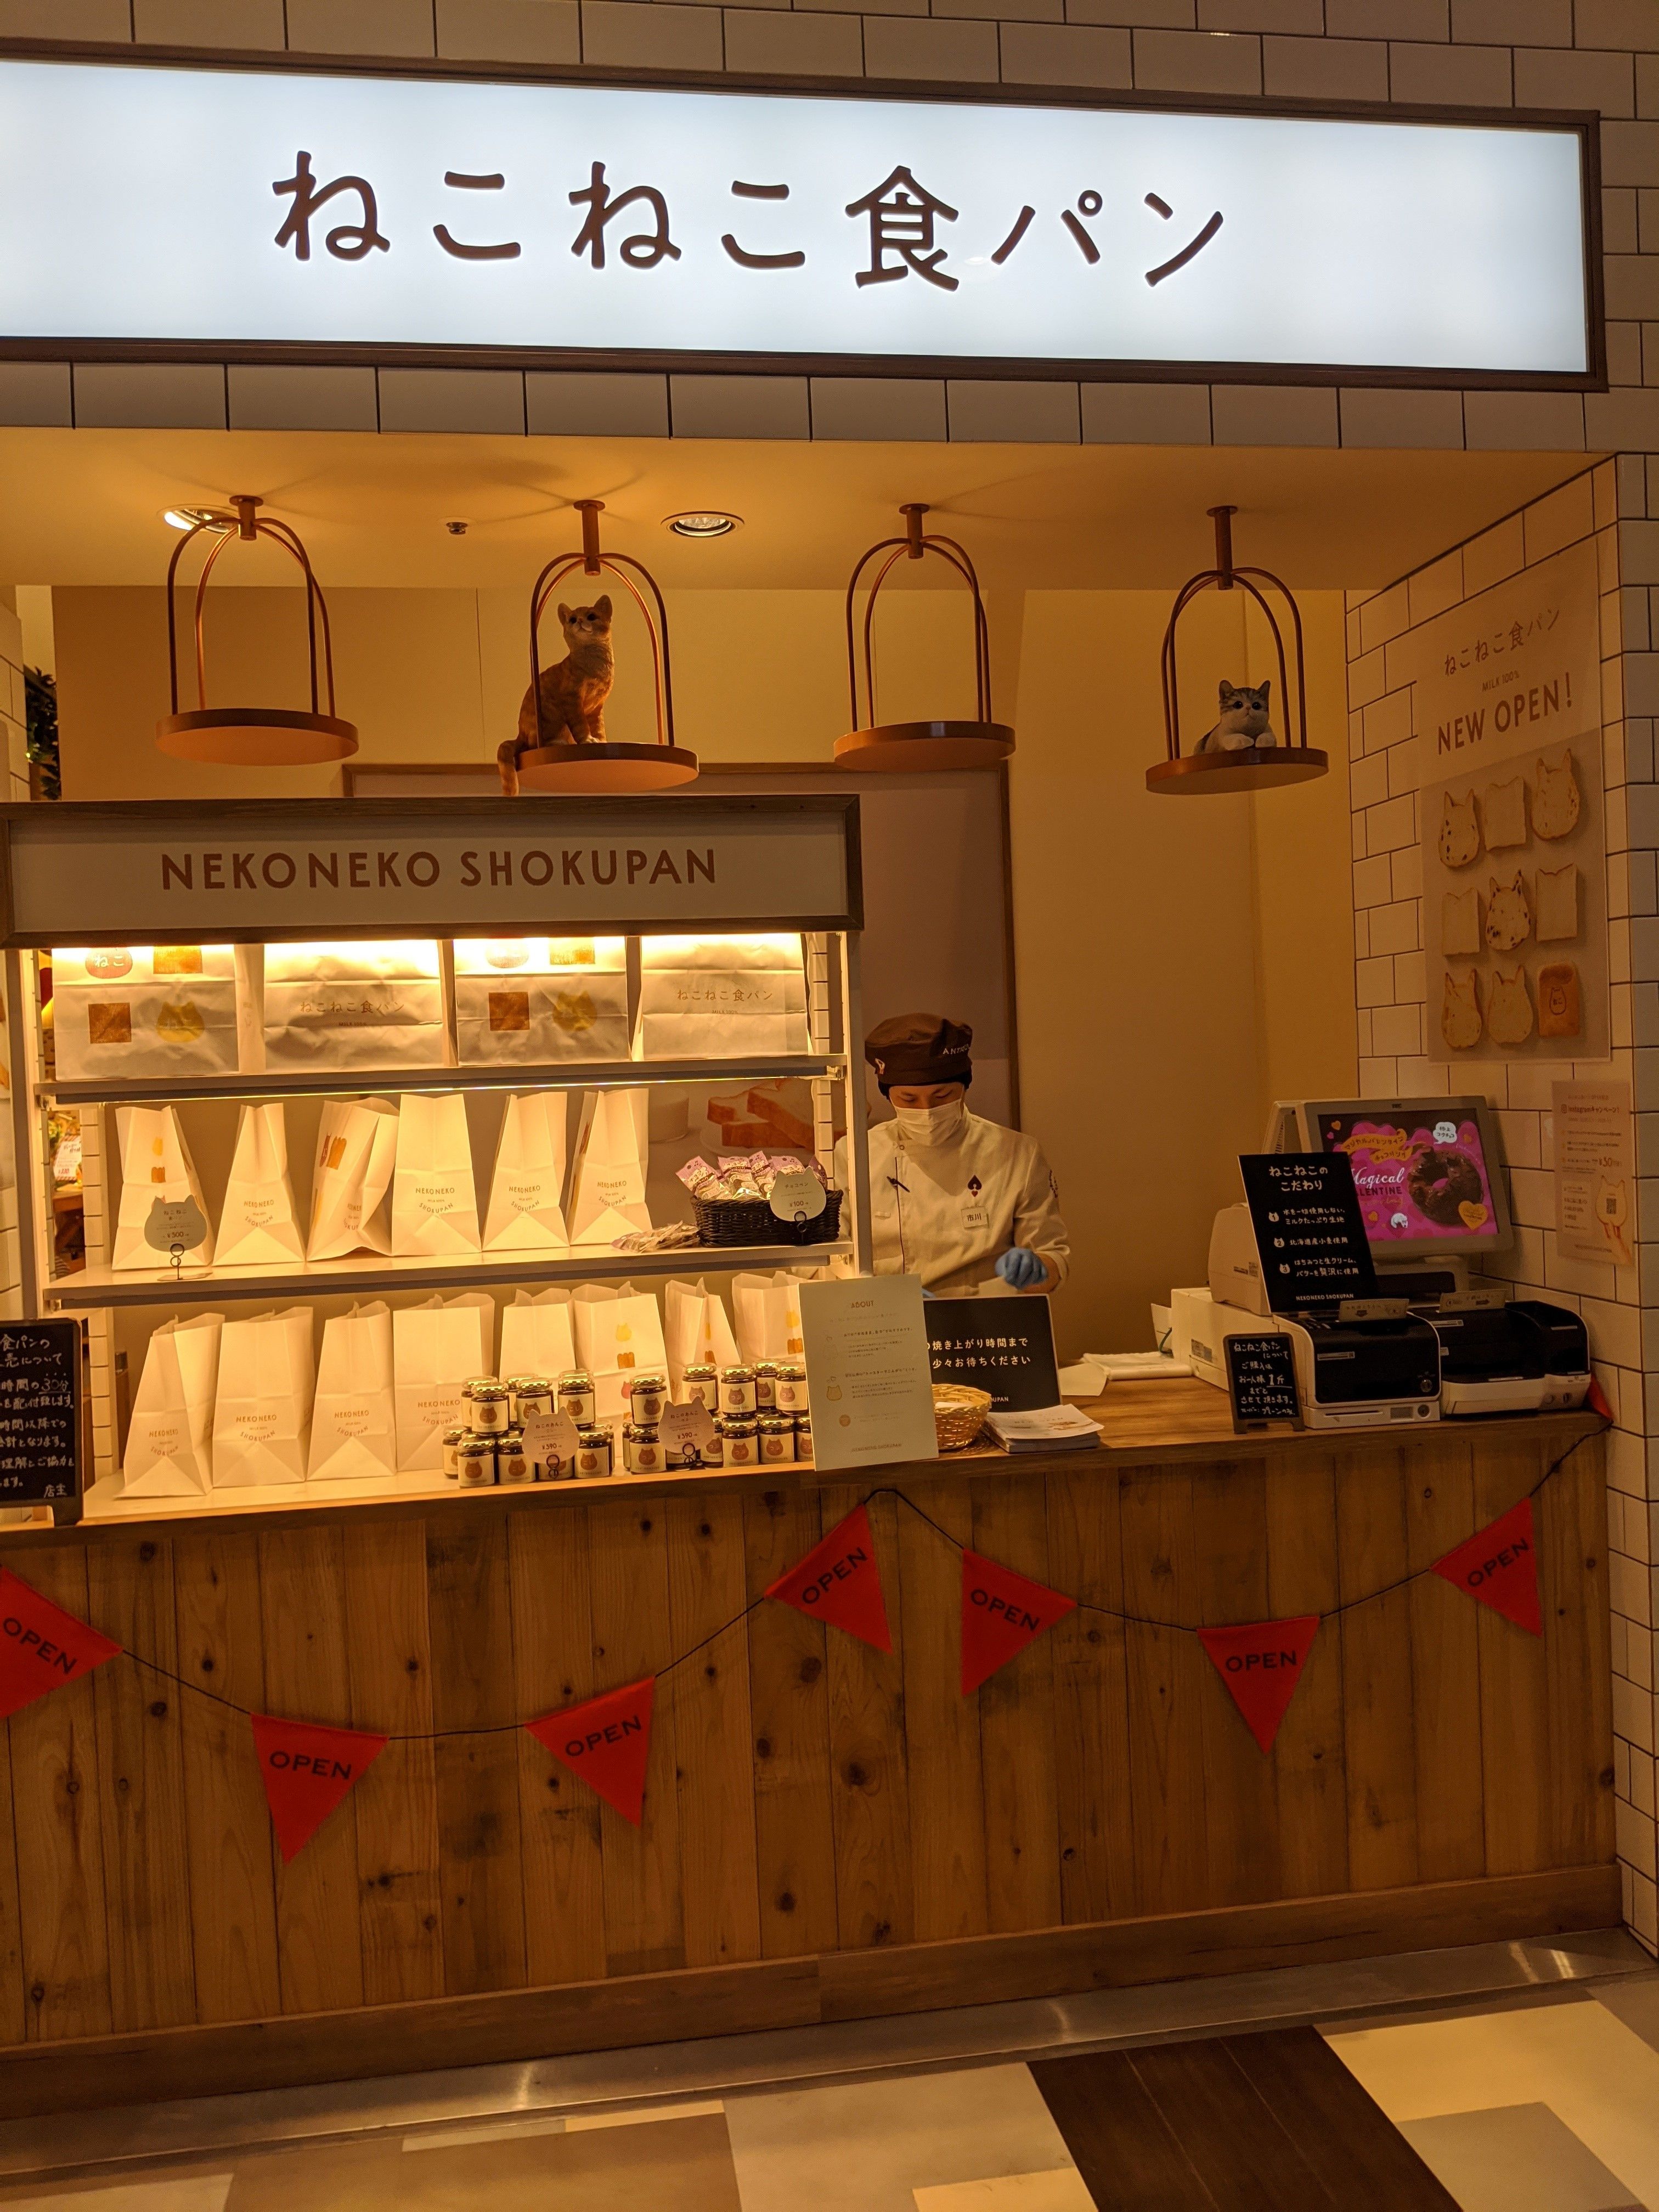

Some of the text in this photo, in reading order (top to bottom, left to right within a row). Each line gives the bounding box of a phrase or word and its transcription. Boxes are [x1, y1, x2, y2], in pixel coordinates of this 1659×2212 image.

[272, 150, 1223, 292] ねこねこ食パン
[1445, 609, 1559, 676] ねこねこ食パン
[1482, 678, 1499, 692] MILK
[1438, 671, 1572, 755] NEW OPEN!
[460, 849, 715, 887] SHOKUPAN
[94, 955, 125, 968] ねこ
[677, 989, 772, 1001] ねこねこ食パン
[300, 1000, 405, 1017] ねこねこ食パン
[1268, 1165, 1329, 1177] ねこねこの
[1281, 1180, 1323, 1191] こだわり
[966, 1213, 982, 1222] 市川
[1285, 1216, 1345, 1225] ミルクたっぷり生地
[1290, 1237, 1348, 1245] 北海道産小麦使用
[851, 1300, 874, 1308] ABOUT
[933, 1356, 1031, 1369] 少々お待ちください
[1263, 1351, 1289, 1360] について
[1465, 1536, 1531, 1589] OPEN
[800, 1545, 868, 1607] OPEN
[968, 1588, 1042, 1632] OPEN
[2, 1617, 78, 1677] OPEN
[1224, 1649, 1298, 1674] OPEN
[565, 1715, 642, 1759] OPEN
[269, 1750, 352, 1781] OPEN
